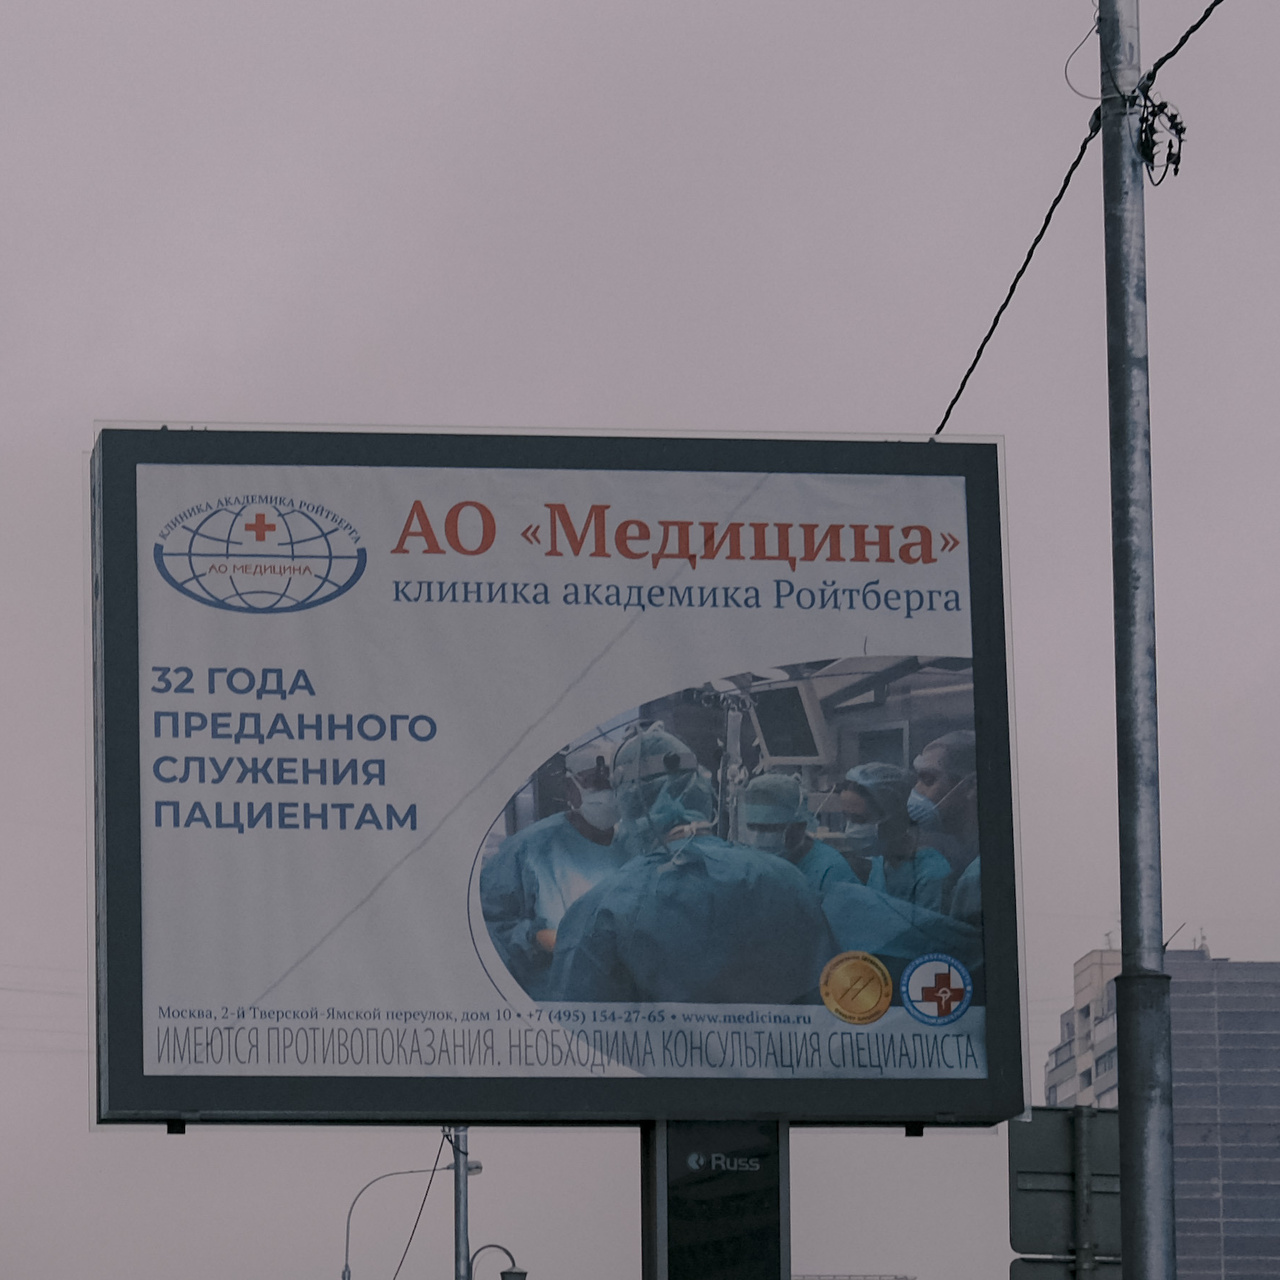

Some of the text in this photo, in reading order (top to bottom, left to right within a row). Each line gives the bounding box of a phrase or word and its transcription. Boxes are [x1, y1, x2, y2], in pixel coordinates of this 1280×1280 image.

[158, 494, 362, 545] КЛИНИКА АКАДЕМИКА РОЙТБЕРГА
[390, 499, 960, 572] АО «Медицина»
[208, 563, 313, 577] АО МЕДИЦИНА
[392, 578, 961, 619] клиника академика Ройтберга
[151, 666, 316, 700] 32 ГОДА
[153, 711, 438, 744] ПРЕДАННОГО
[152, 755, 386, 786] СЛУЖЕНИЯ
[154, 800, 418, 834] ПАЦИЕНТАМ
[158, 1006, 812, 1025] Москва, 2-й Тверской-Ямской переулок, дом 10 +7 (495) 154-27-65 www.medicina.ru
[157, 1026, 979, 1076] ИМЕЮТСЯ ПРОТИВОПОКАЗАНИЯ. НЕОБХОДИМА КОНСУЛЬТАЦИЯ СПЕЦИАЛИСТА
[711, 1153, 761, 1171] Russ
